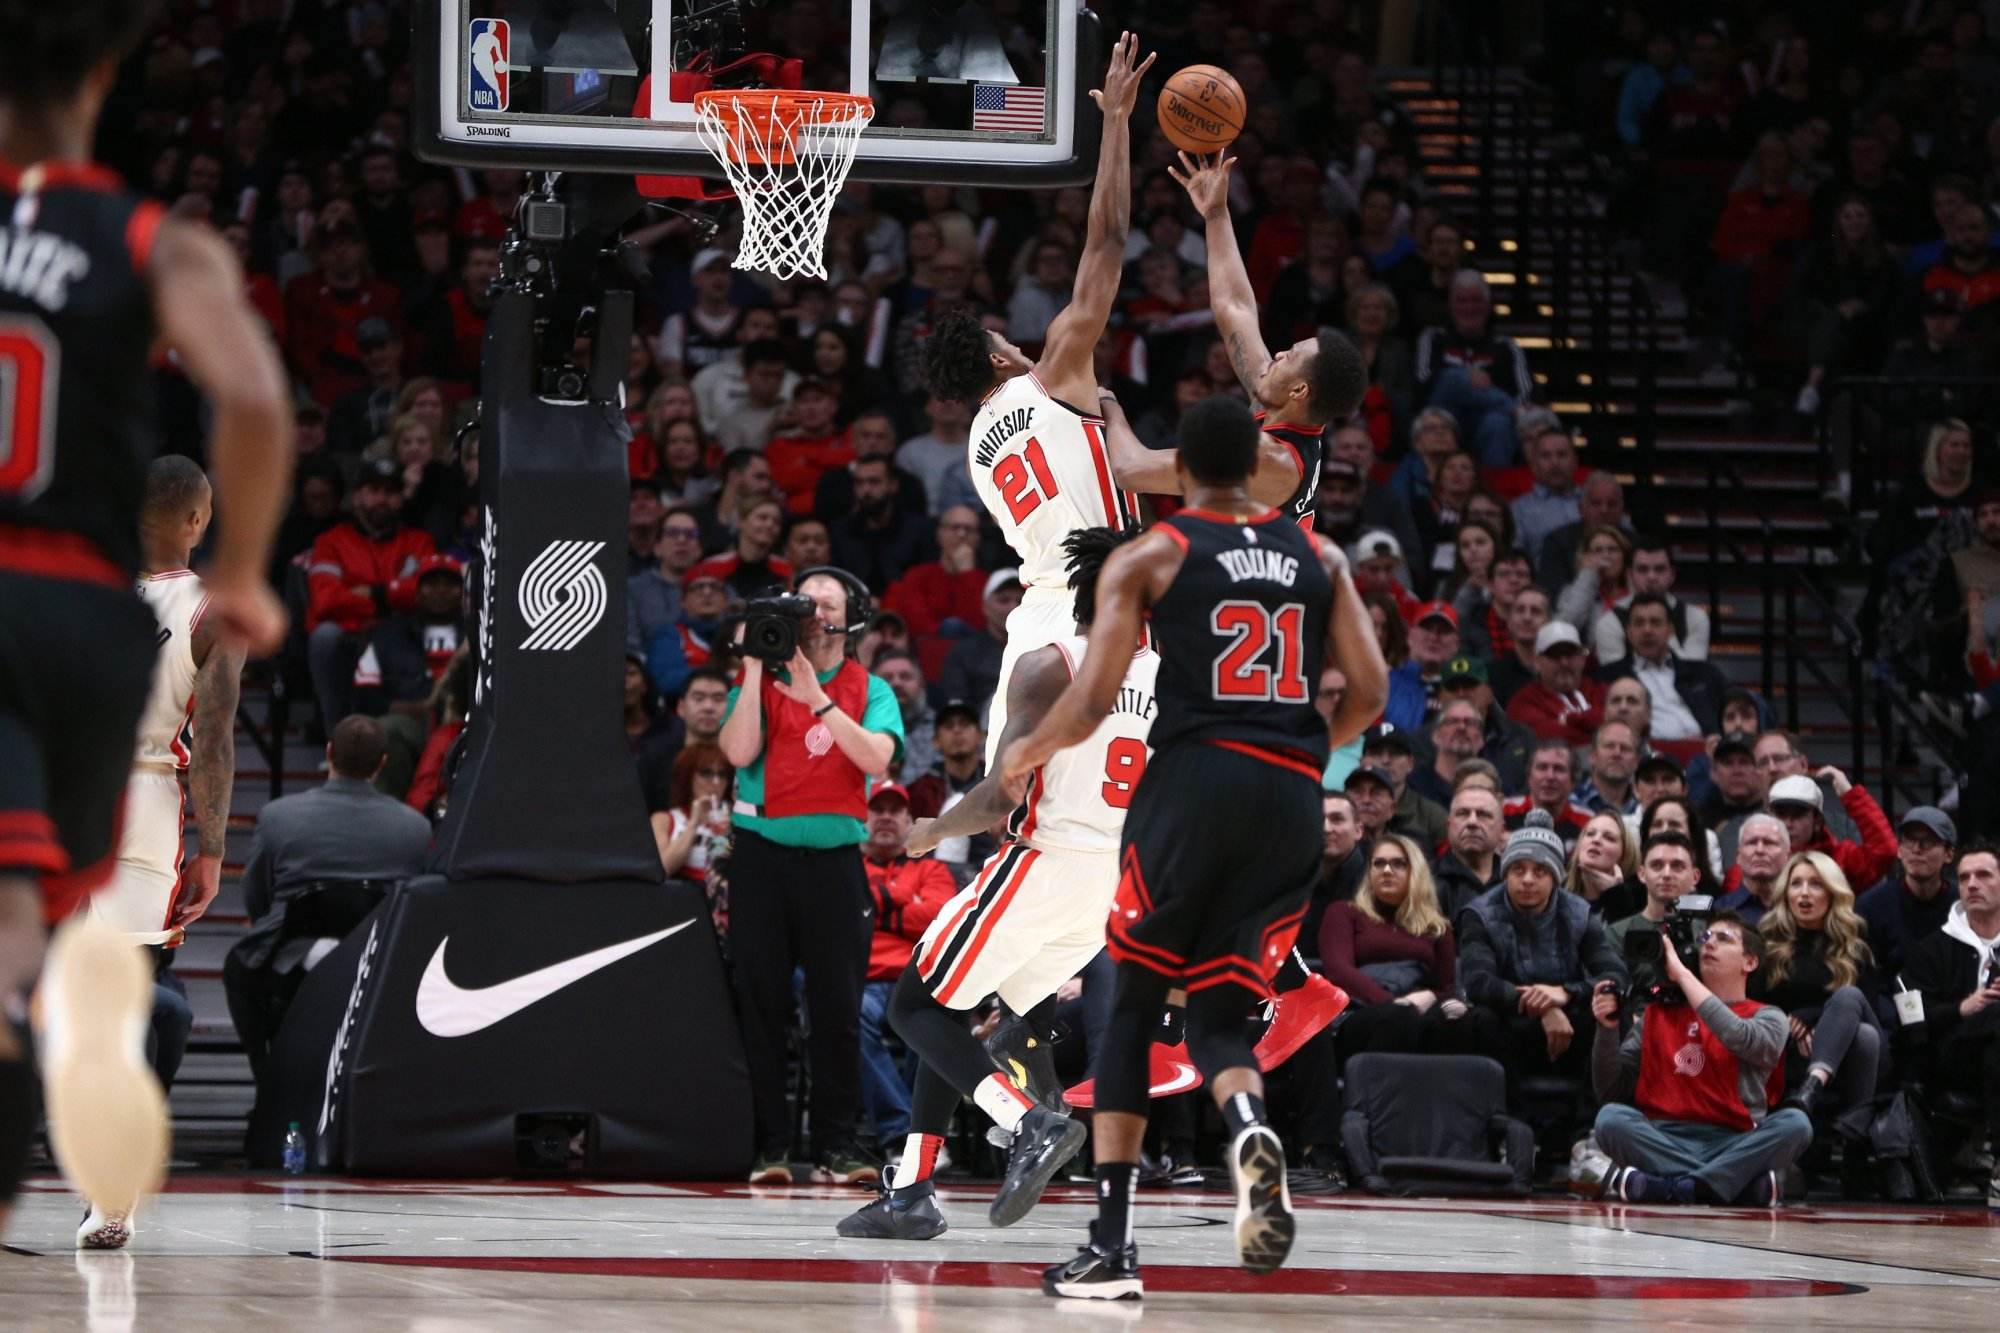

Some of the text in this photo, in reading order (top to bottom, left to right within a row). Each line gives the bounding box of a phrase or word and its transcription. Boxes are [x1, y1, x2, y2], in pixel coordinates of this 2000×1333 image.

[474, 90, 494, 105] NBA
[1167, 95, 1225, 136] SPALDING
[466, 125, 511, 138] SPALDING
[976, 407, 1035, 468] WHITESIDE
[992, 435, 1059, 527] 21
[1216, 548, 1300, 587] YOUNG
[1210, 600, 1310, 704] 21
[1110, 687, 1156, 720] TTLE
[1101, 736, 1148, 809] 9
[1687, 1021, 1700, 1037] 2
